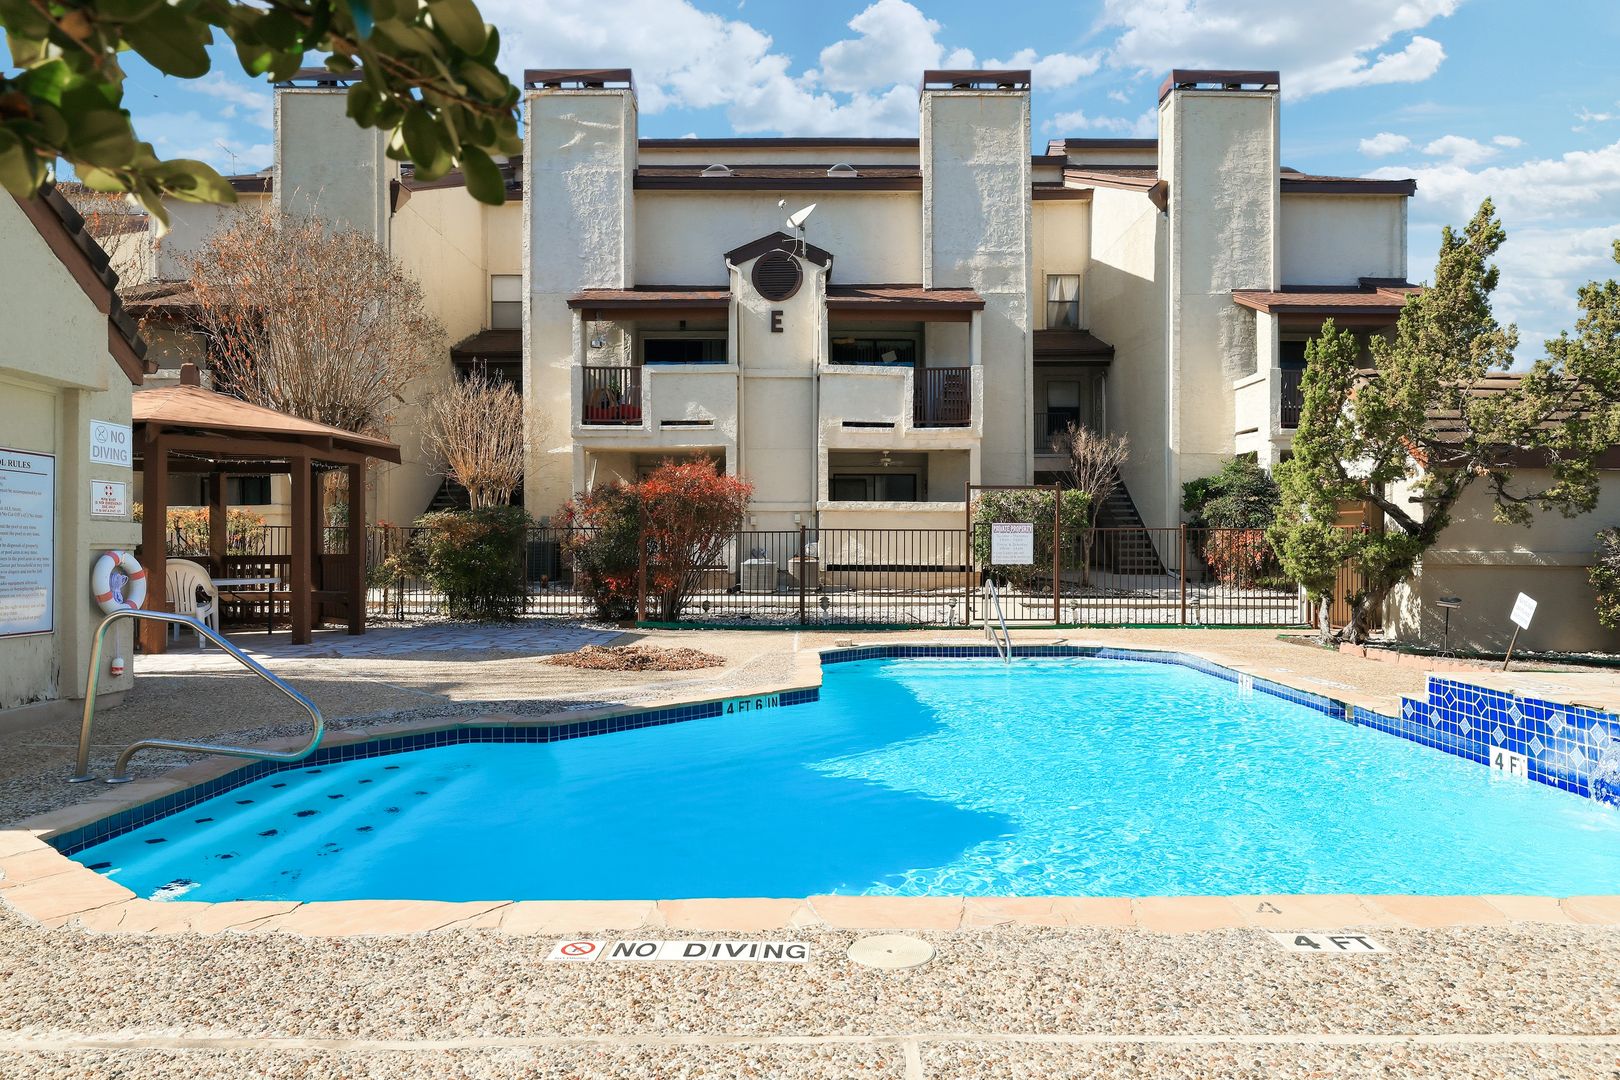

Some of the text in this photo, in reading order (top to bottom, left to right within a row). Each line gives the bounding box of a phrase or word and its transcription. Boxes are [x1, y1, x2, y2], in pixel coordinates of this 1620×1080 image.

[771, 310, 784, 333] E
[110, 430, 125, 444] NO
[92, 445, 127, 461] DIVING
[7, 459, 31, 469] RULES
[727, 696, 778, 714] 4 FT 6 IN
[1495, 752, 1504, 770] 4
[612, 942, 806, 959] NO DIVING
[1294, 935, 1375, 950] 4 FT
